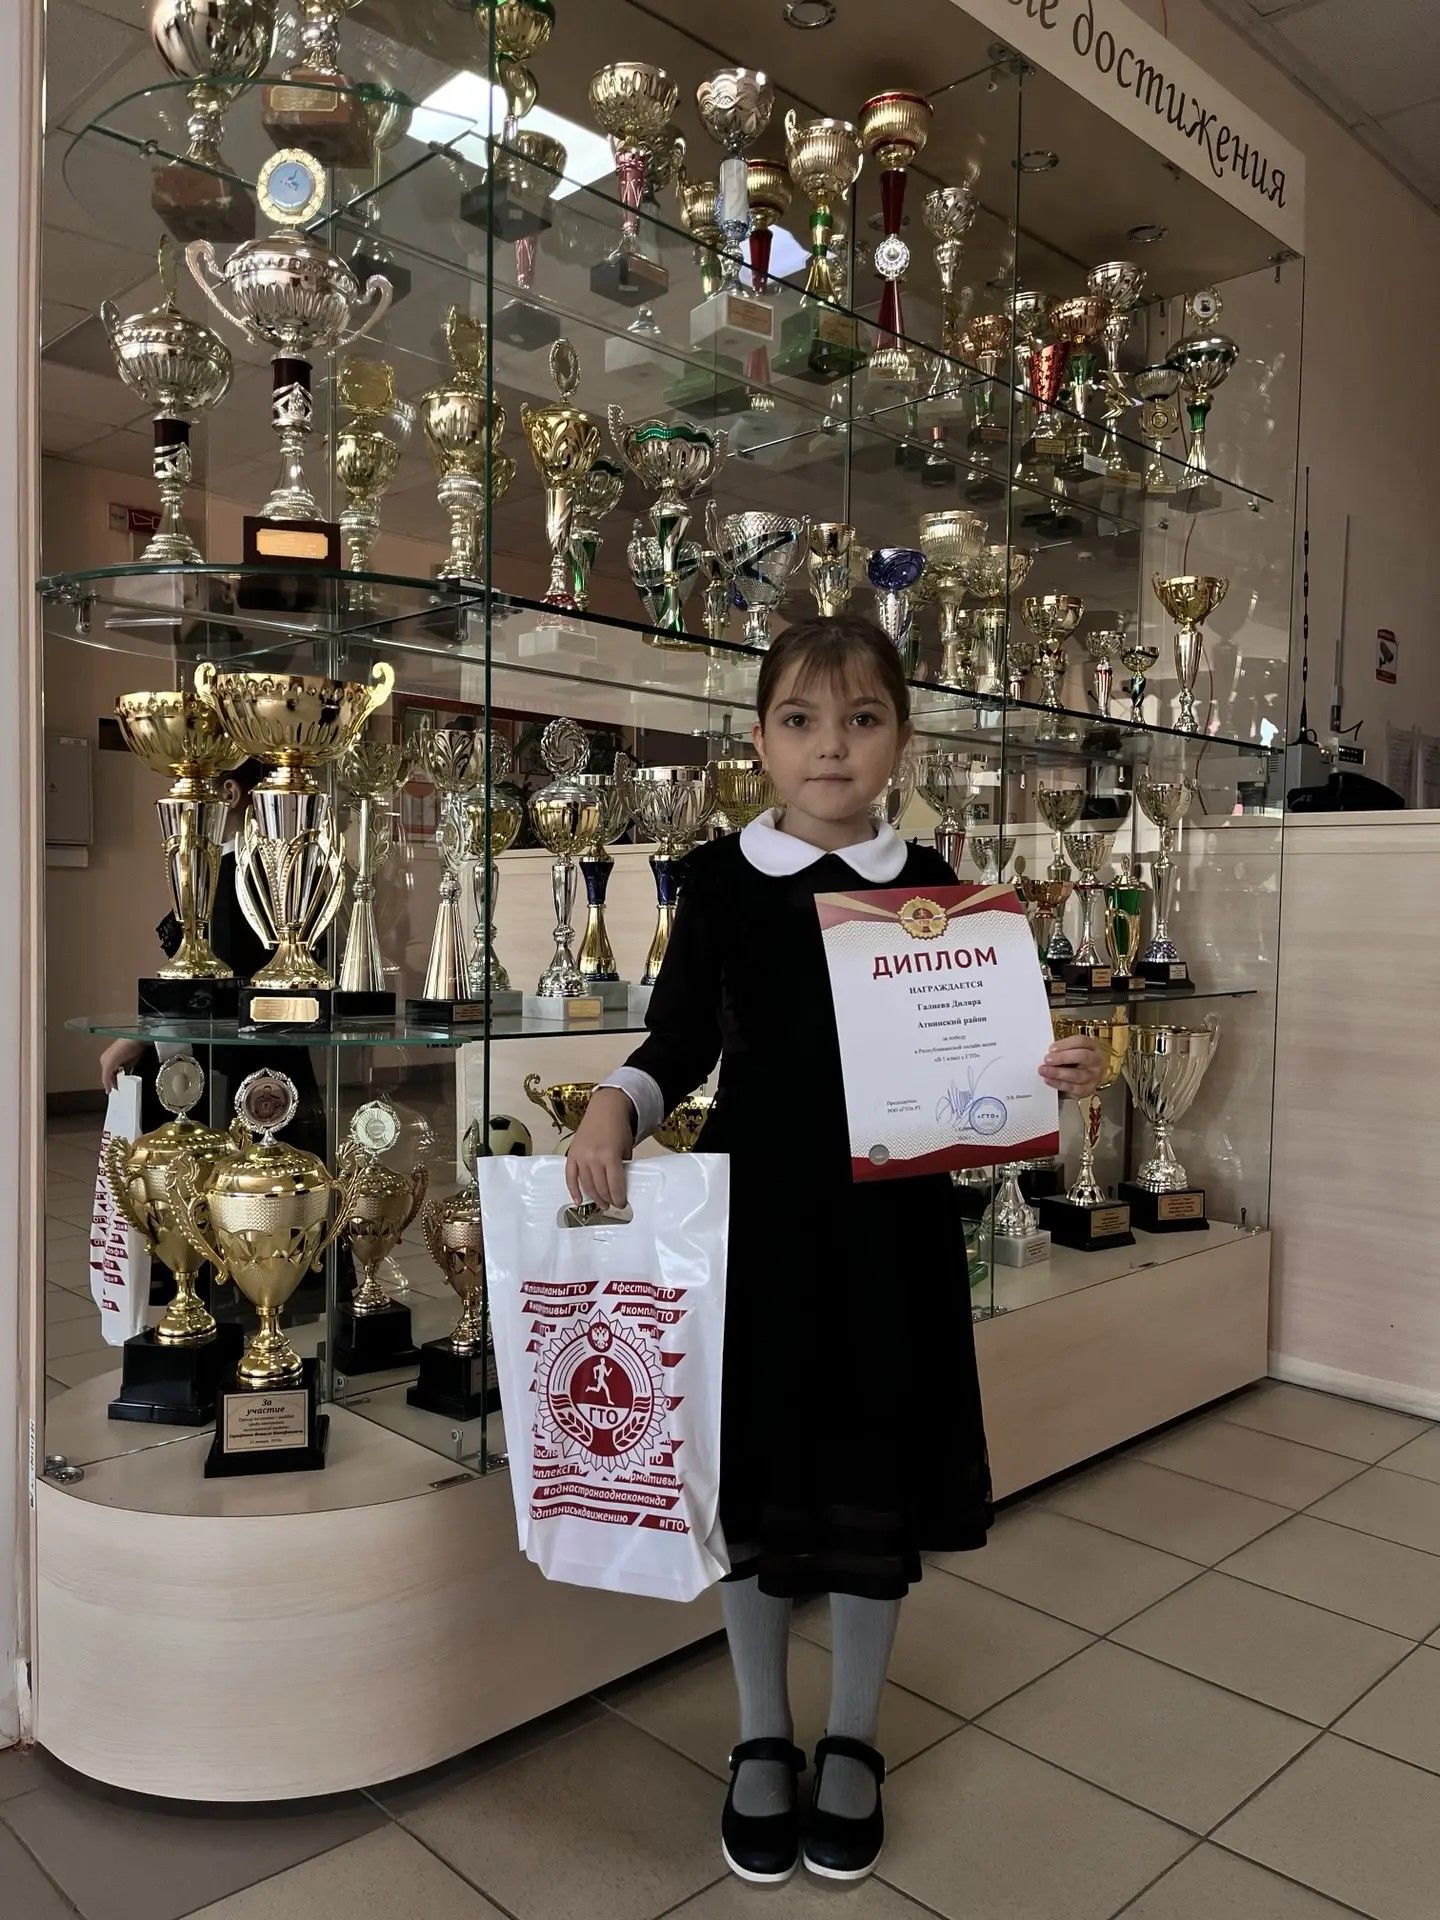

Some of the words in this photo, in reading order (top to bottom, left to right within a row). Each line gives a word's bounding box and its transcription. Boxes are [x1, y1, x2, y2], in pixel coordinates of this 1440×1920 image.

[1072, 0, 1287, 209] достижения
[872, 946, 998, 980] ДИПЛОМ
[909, 980, 983, 994] НАГРАЖДАЕТСЯ
[917, 1002, 950, 1011] Галиева
[951, 999, 982, 1009] Диляра
[963, 1015, 987, 1026] район
[246, 1406, 285, 1416] участие
[589, 1407, 619, 1425] ГТО
[659, 1517, 685, 1532] #ГТО
